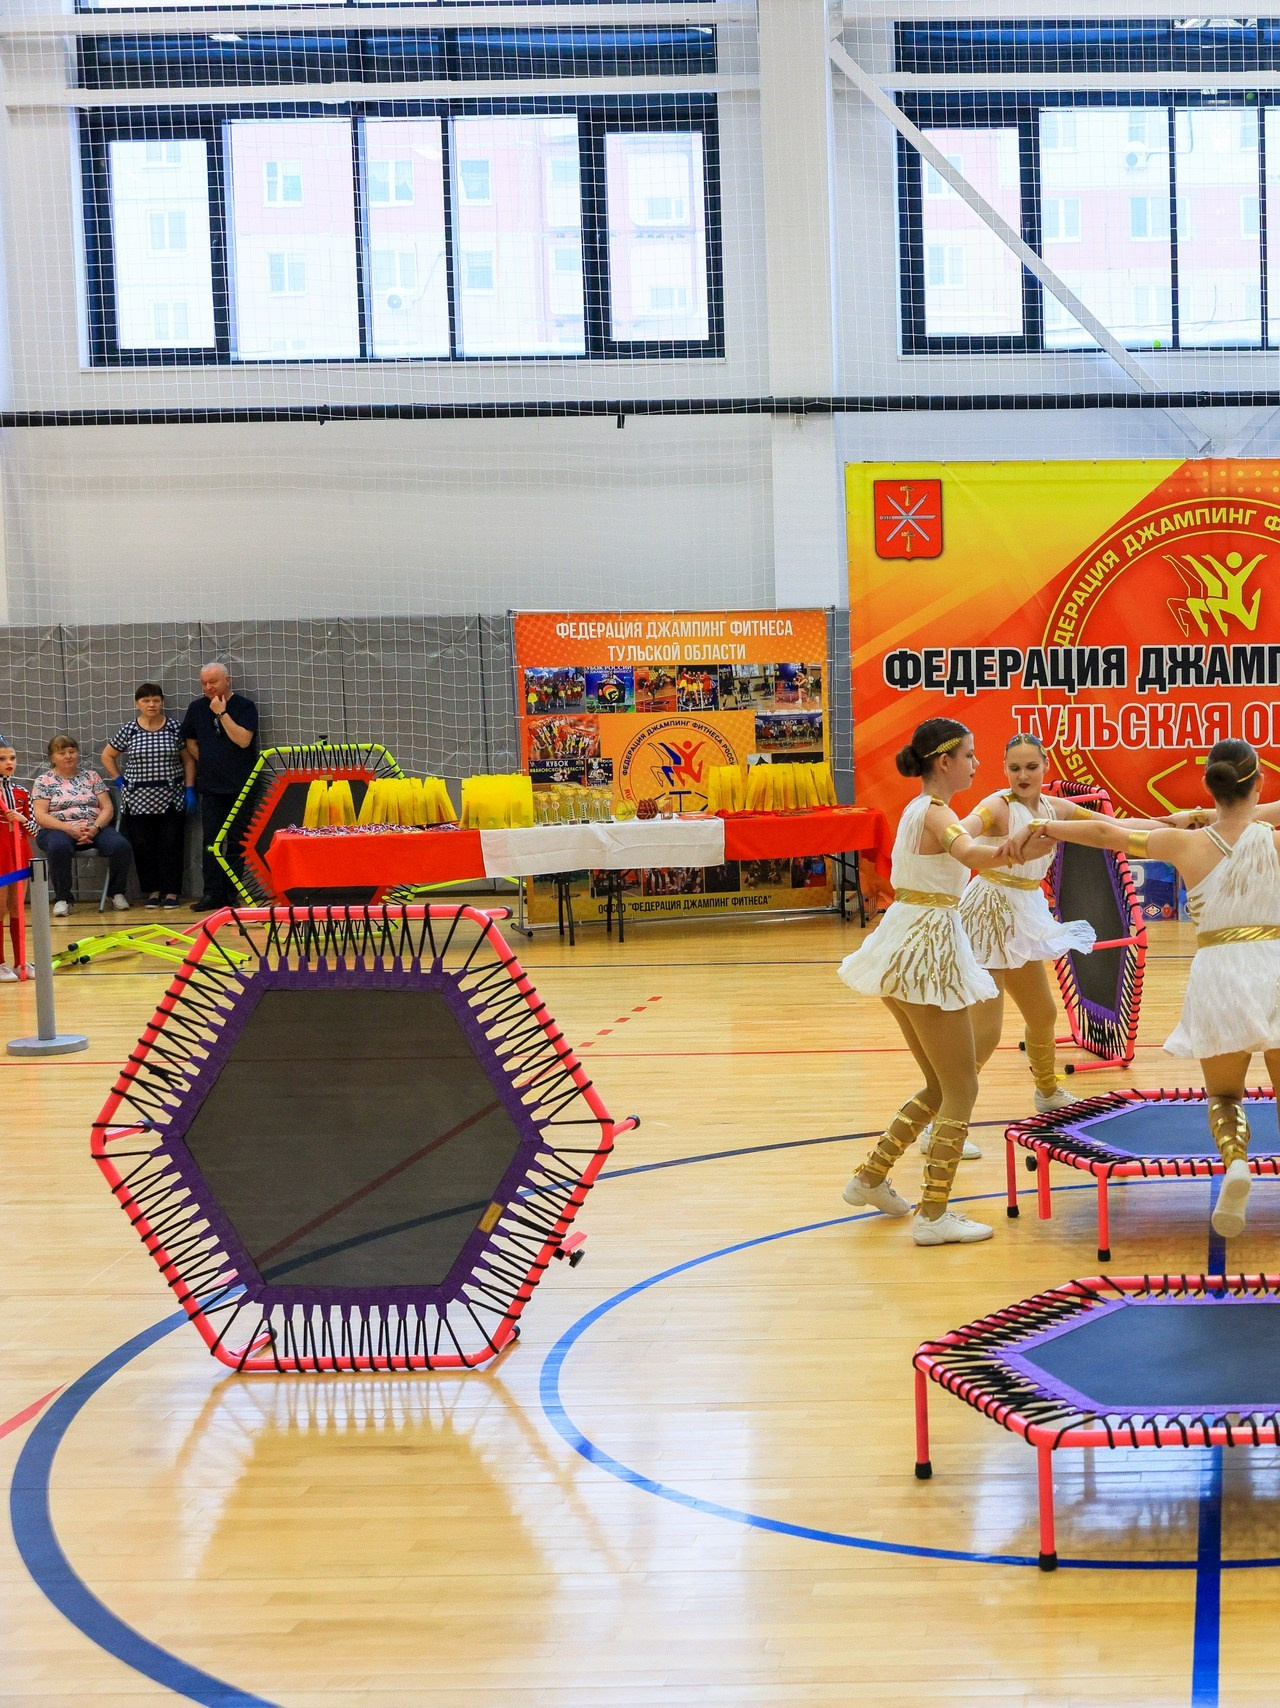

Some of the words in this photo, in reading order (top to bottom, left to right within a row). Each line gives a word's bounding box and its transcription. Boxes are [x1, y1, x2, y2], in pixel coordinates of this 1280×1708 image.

[1053, 549, 1120, 647] ДЕРАЦИЯ
[1122, 507, 1257, 557] ДЖАМПИНГ
[555, 621, 643, 640] ФЕДЕРАЦИЯ
[645, 620, 727, 639] ДЖАМПИНГ
[729, 619, 794, 637] ФИТНЕСА
[607, 641, 681, 661] ТУЛЬСКОЙ
[684, 643, 746, 660] ОБЛАСТИ
[883, 645, 1127, 697] ФЕДЕРАЦИЯ
[622, 733, 646, 776] ФЕДЕРАЦИЯ
[647, 720, 691, 736] ДЖАМПИНГ
[692, 722, 723, 744] ФИТНЕСА
[1012, 702, 1231, 751] ТУЛЬСКАЯ
[627, 901, 681, 912] "ФЕДЕРАЦИЯ
[682, 897, 729, 910] ДЖАМПИНГ
[731, 894, 772, 907] ФИТНЕСА"
